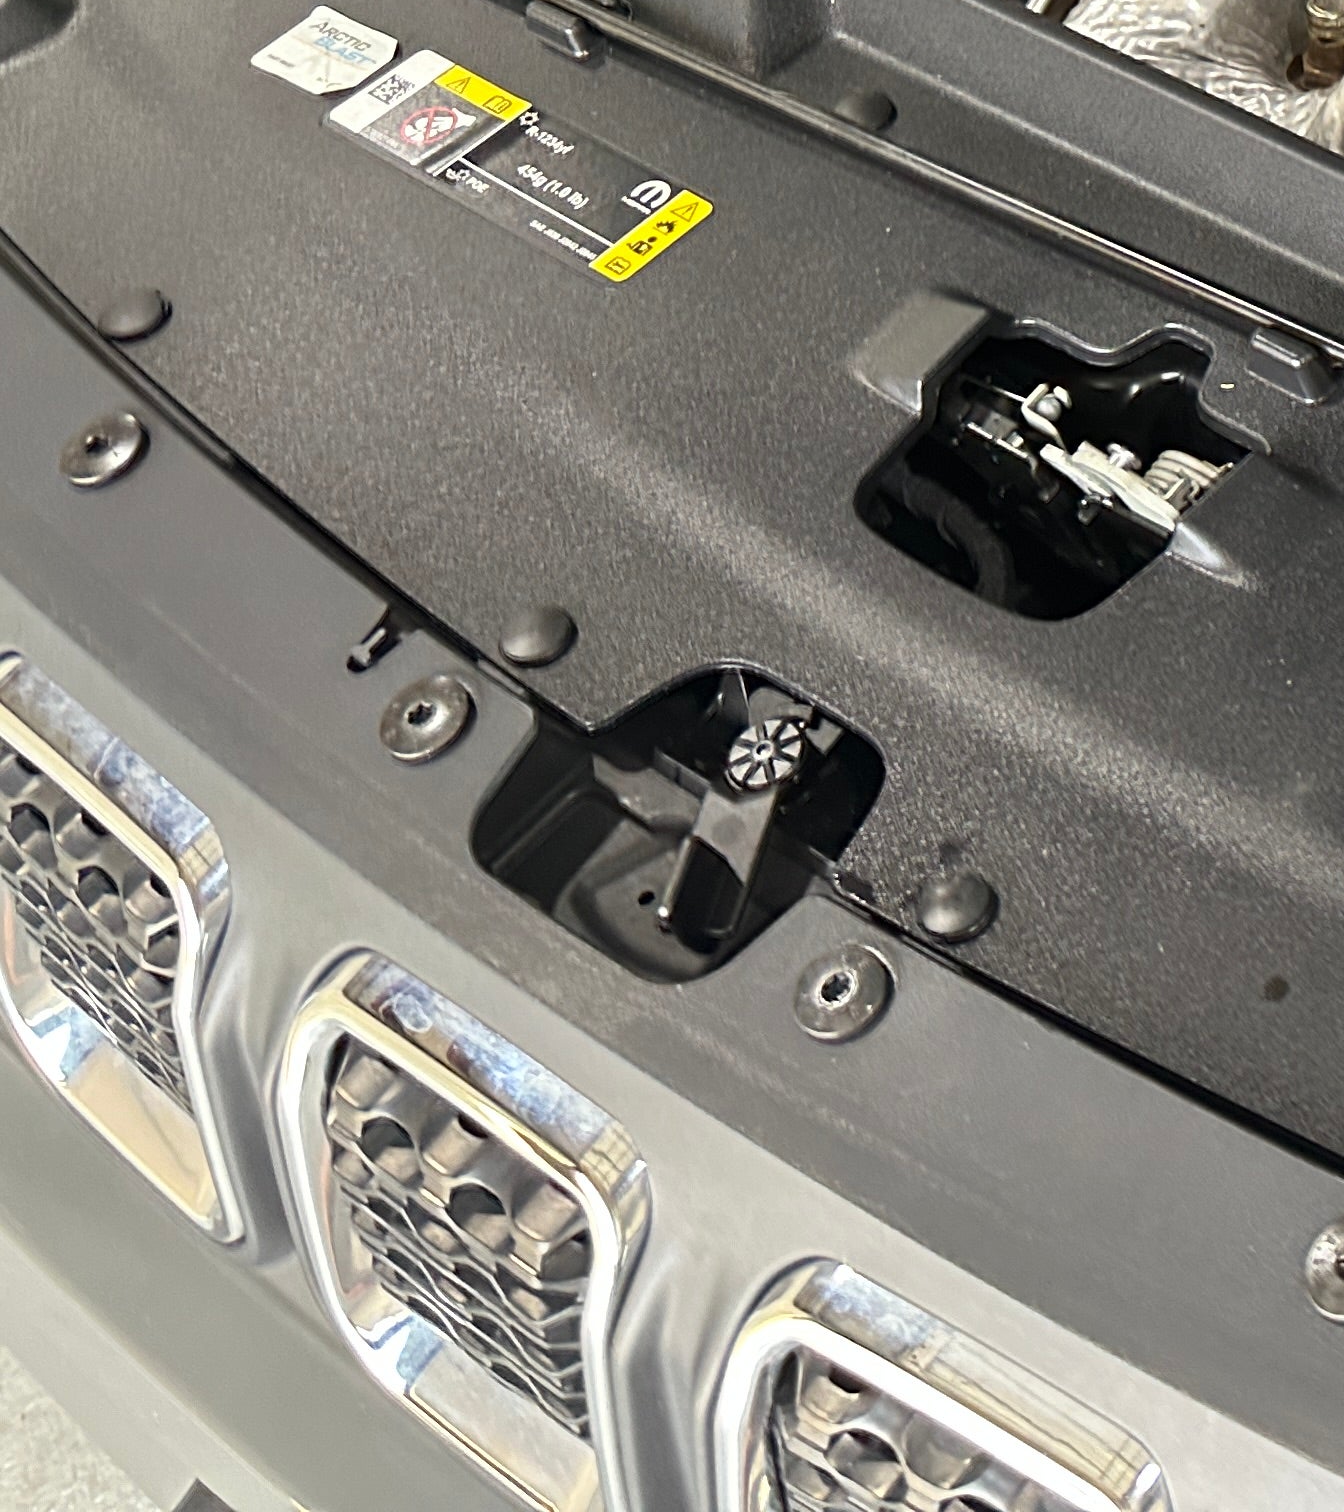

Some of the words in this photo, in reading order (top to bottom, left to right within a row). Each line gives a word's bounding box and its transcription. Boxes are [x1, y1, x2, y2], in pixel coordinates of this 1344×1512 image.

[309, 21, 371, 51] ARCTIC
[313, 36, 371, 64] BLAST
[466, 176, 490, 194] POE
[517, 164, 548, 188] 454g
